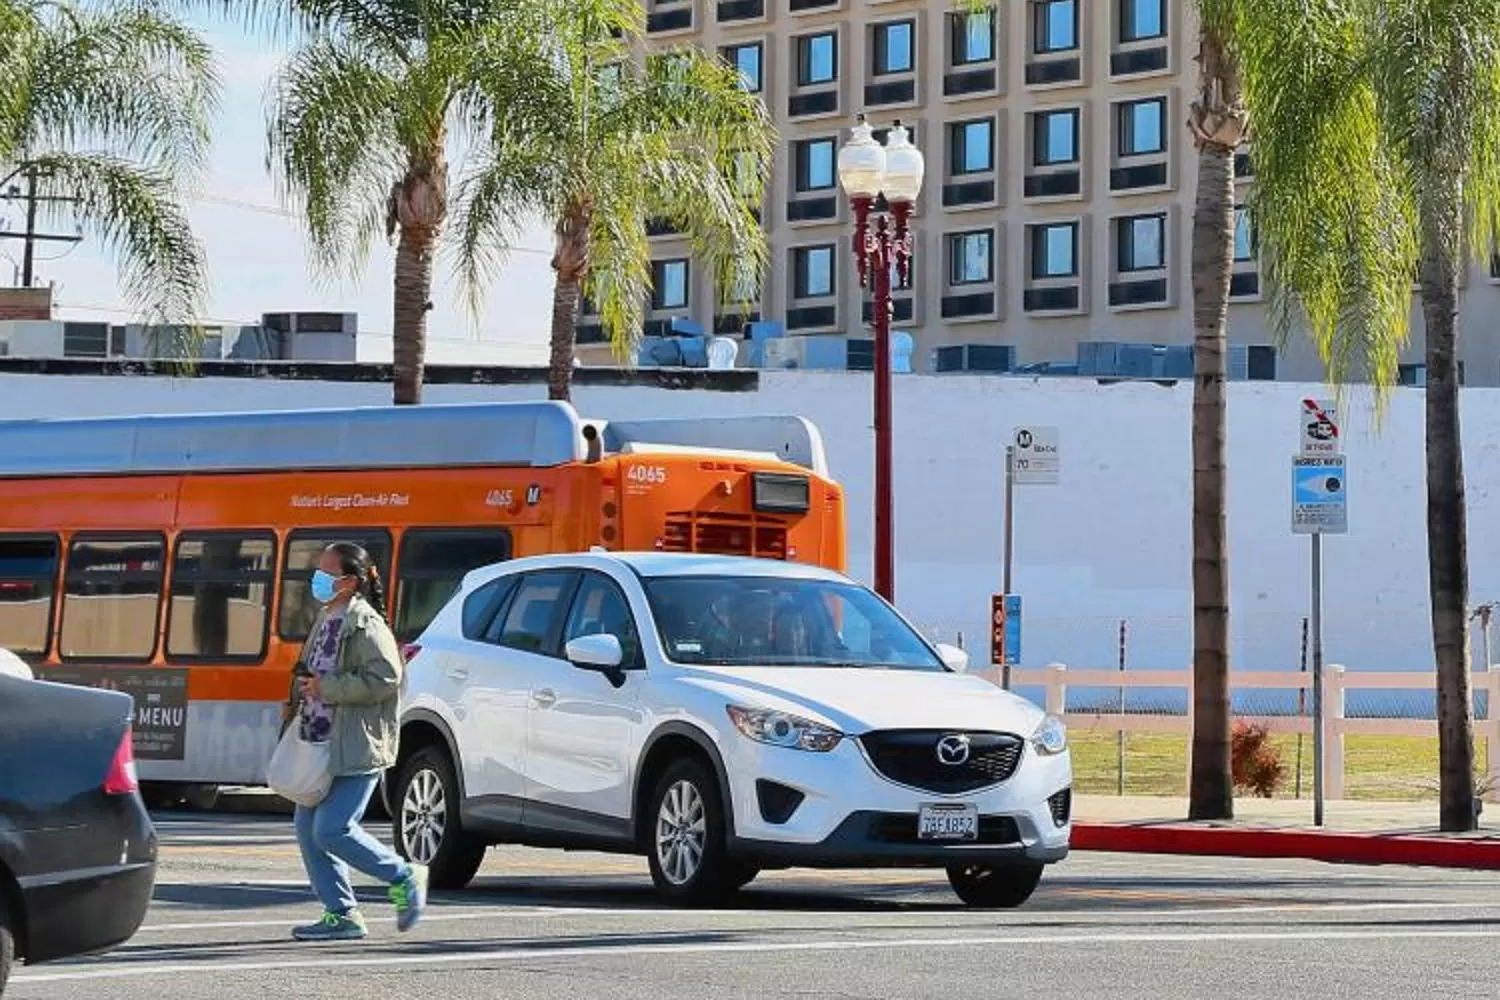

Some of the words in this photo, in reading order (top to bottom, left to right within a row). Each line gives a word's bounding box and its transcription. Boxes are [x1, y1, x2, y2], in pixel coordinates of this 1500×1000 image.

[627, 464, 666, 484] 4065
[485, 489, 513, 507] 4065
[138, 706, 184, 728] MENU
